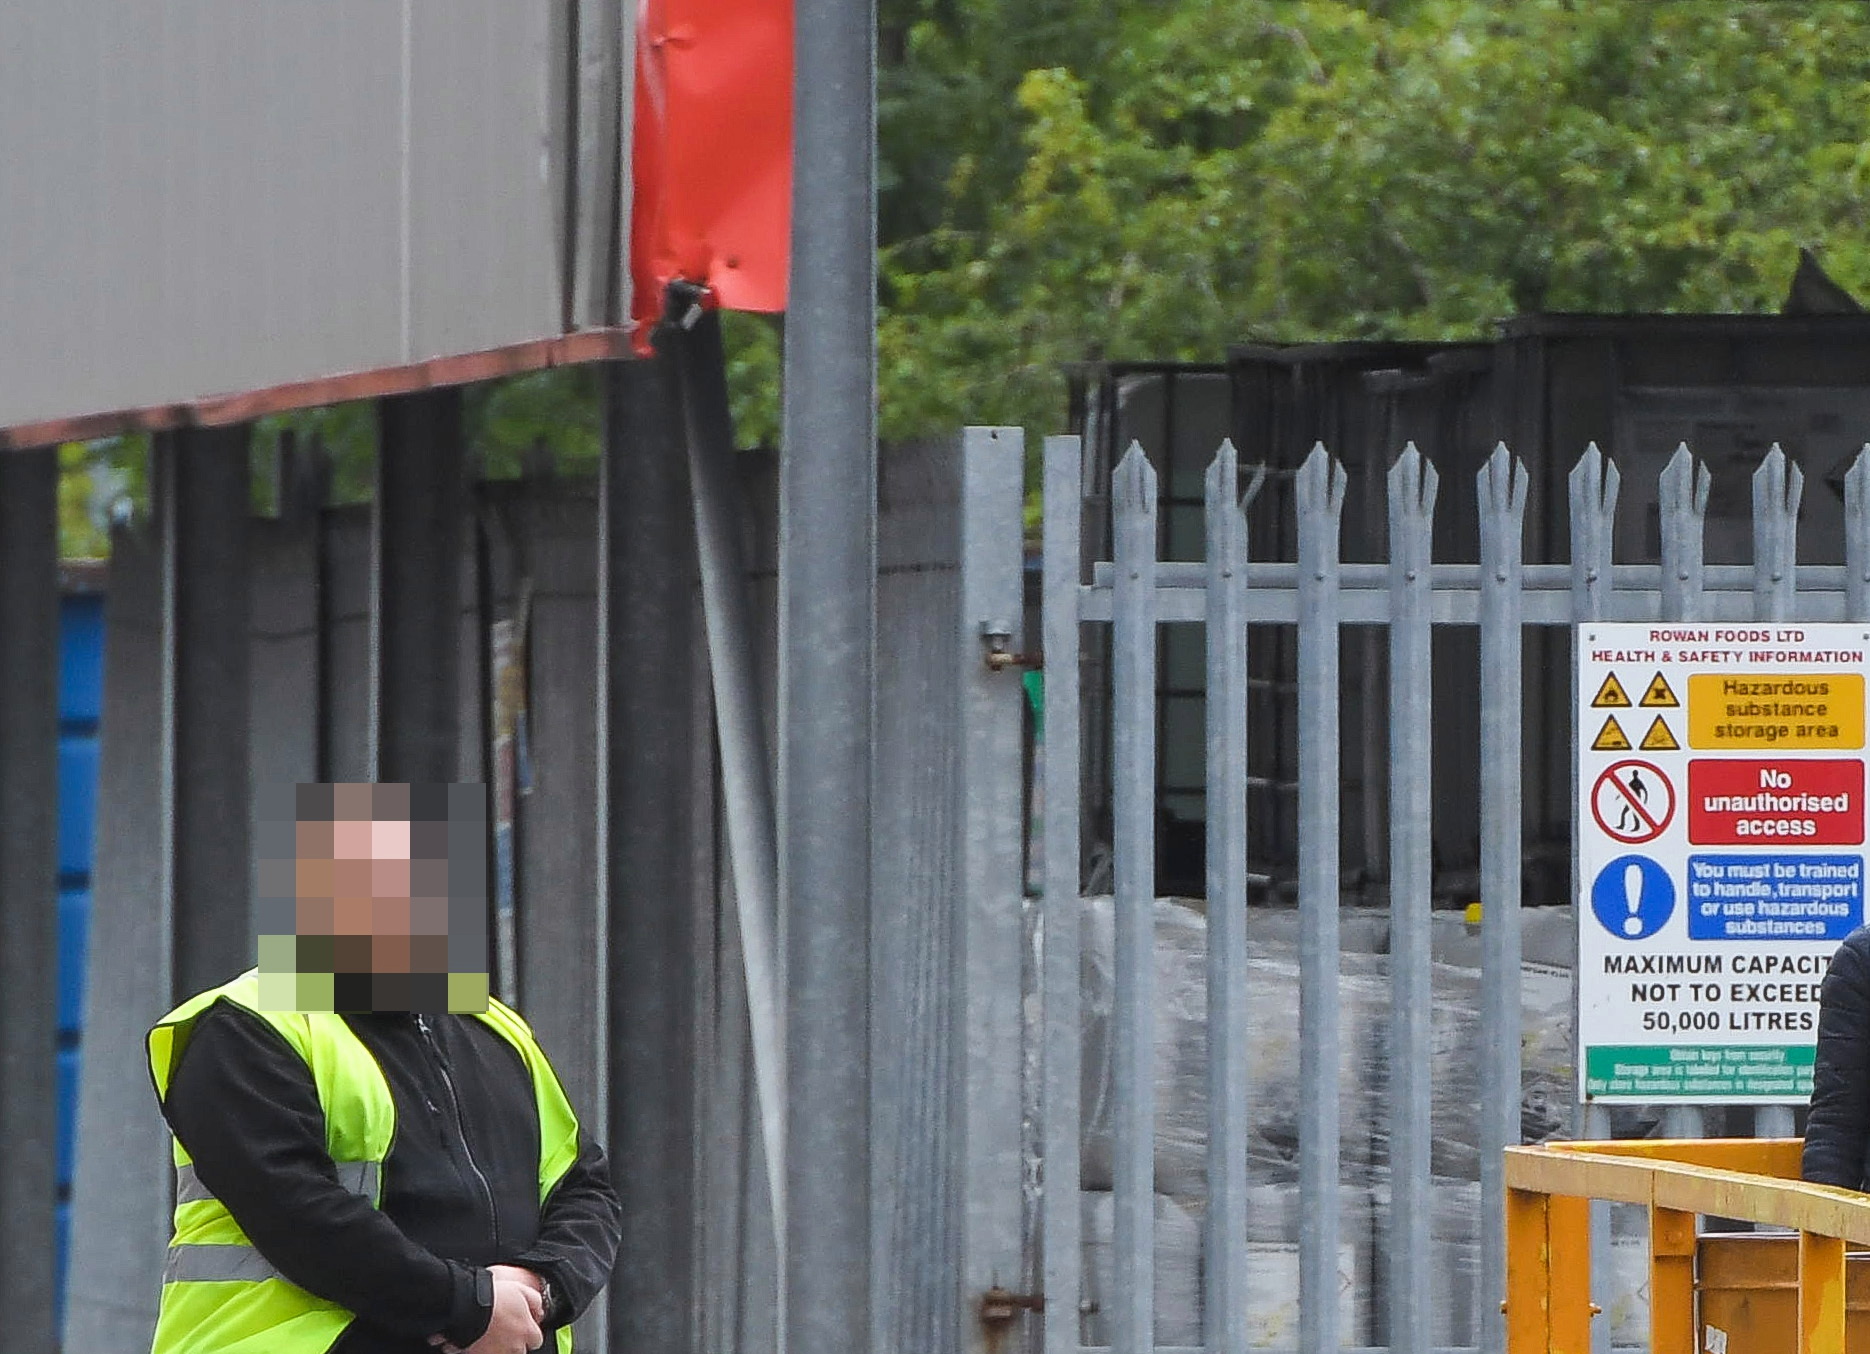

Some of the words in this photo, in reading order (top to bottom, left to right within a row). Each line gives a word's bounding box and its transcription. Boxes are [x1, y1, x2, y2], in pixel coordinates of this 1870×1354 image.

[1649, 630, 1709, 642] ROWAN
[1715, 630, 1771, 642] FOODS
[1777, 631, 1805, 642] LTD
[1592, 651, 1656, 662] HEALTH
[1662, 651, 1671, 662] &
[1679, 651, 1742, 662] SAFETY
[1749, 651, 1863, 662] INFORMATION
[1724, 680, 1829, 695] Hazardous
[1726, 702, 1827, 716] substance
[1715, 724, 1789, 741] storage
[1796, 726, 1839, 737] area
[1760, 769, 1791, 788] No
[1704, 793, 1848, 812] unauthorised
[1736, 818, 1816, 835] access
[1693, 862, 1724, 878] You
[1728, 864, 1770, 878] must
[1774, 863, 1796, 877] be
[1802, 863, 1859, 877] trained
[1693, 883, 1711, 897] to
[1778, 882, 1857, 900] transport
[1701, 903, 1720, 916] or
[1723, 903, 1754, 916] use
[1758, 901, 1849, 916] hazardous
[1725, 920, 1826, 934] substances
[1604, 955, 1722, 974] MAXIMUM
[1732, 955, 1832, 974] CAPACIT
[1631, 984, 1681, 1002] NOT
[1689, 984, 1721, 1002] TO
[1730, 984, 1821, 1002] EXCEED
[1643, 1012, 1720, 1034] 50,000
[1729, 1012, 1813, 1030] LITRES
